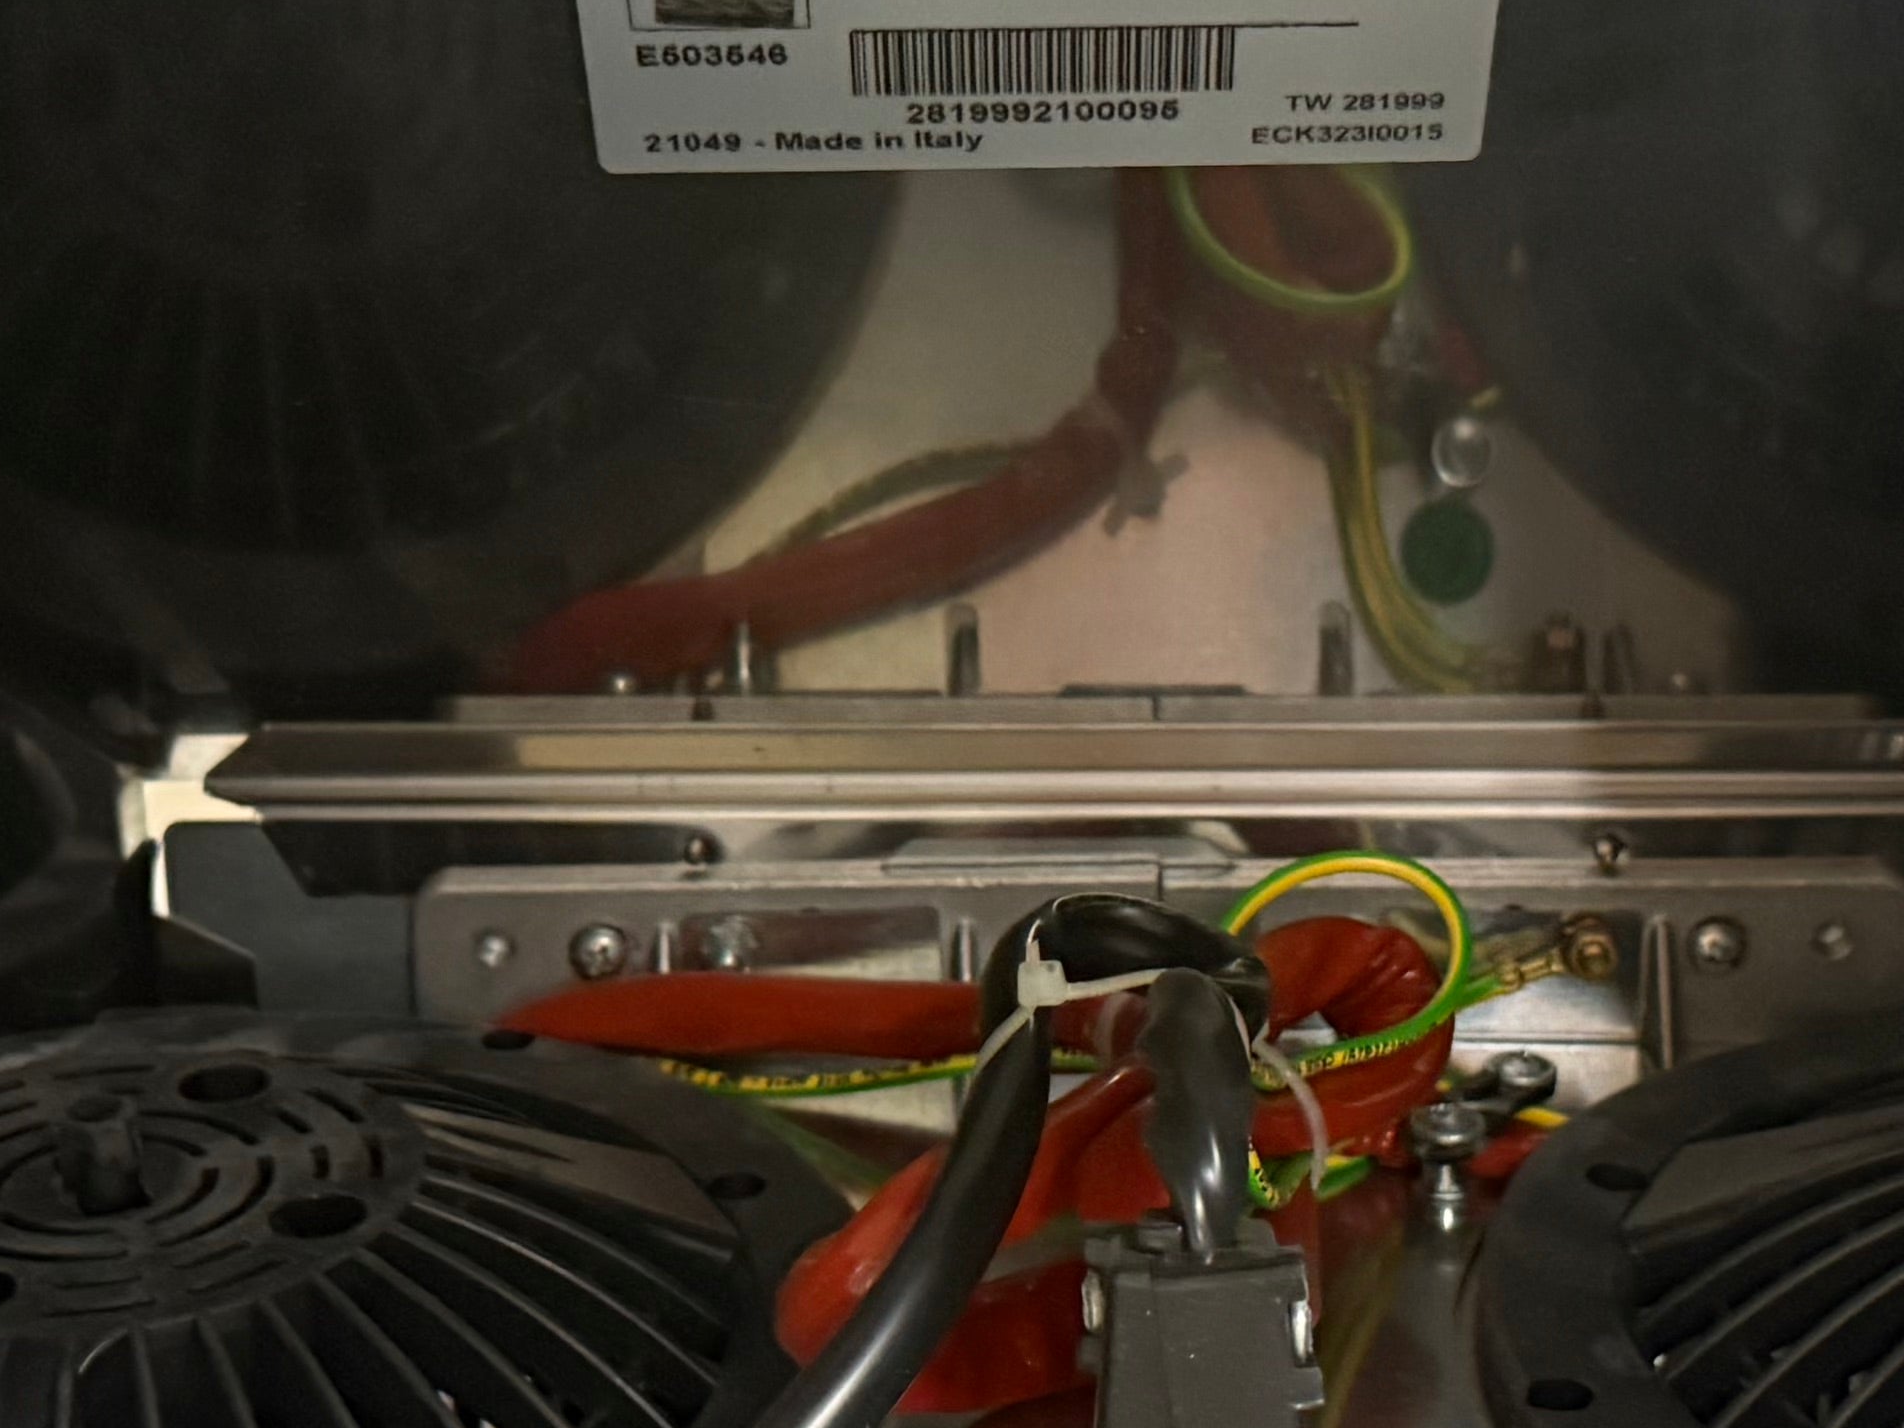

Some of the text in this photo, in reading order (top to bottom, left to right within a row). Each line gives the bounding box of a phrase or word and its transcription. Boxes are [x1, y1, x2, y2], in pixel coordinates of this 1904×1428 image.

[636, 44, 788, 68] E503546
[906, 99, 1179, 125] 2819992100095
[1286, 92, 1445, 112] TW 281999
[644, 133, 741, 153] 21049
[776, 132, 862, 151] Made
[876, 131, 904, 149] in
[915, 131, 983, 152] Italy
